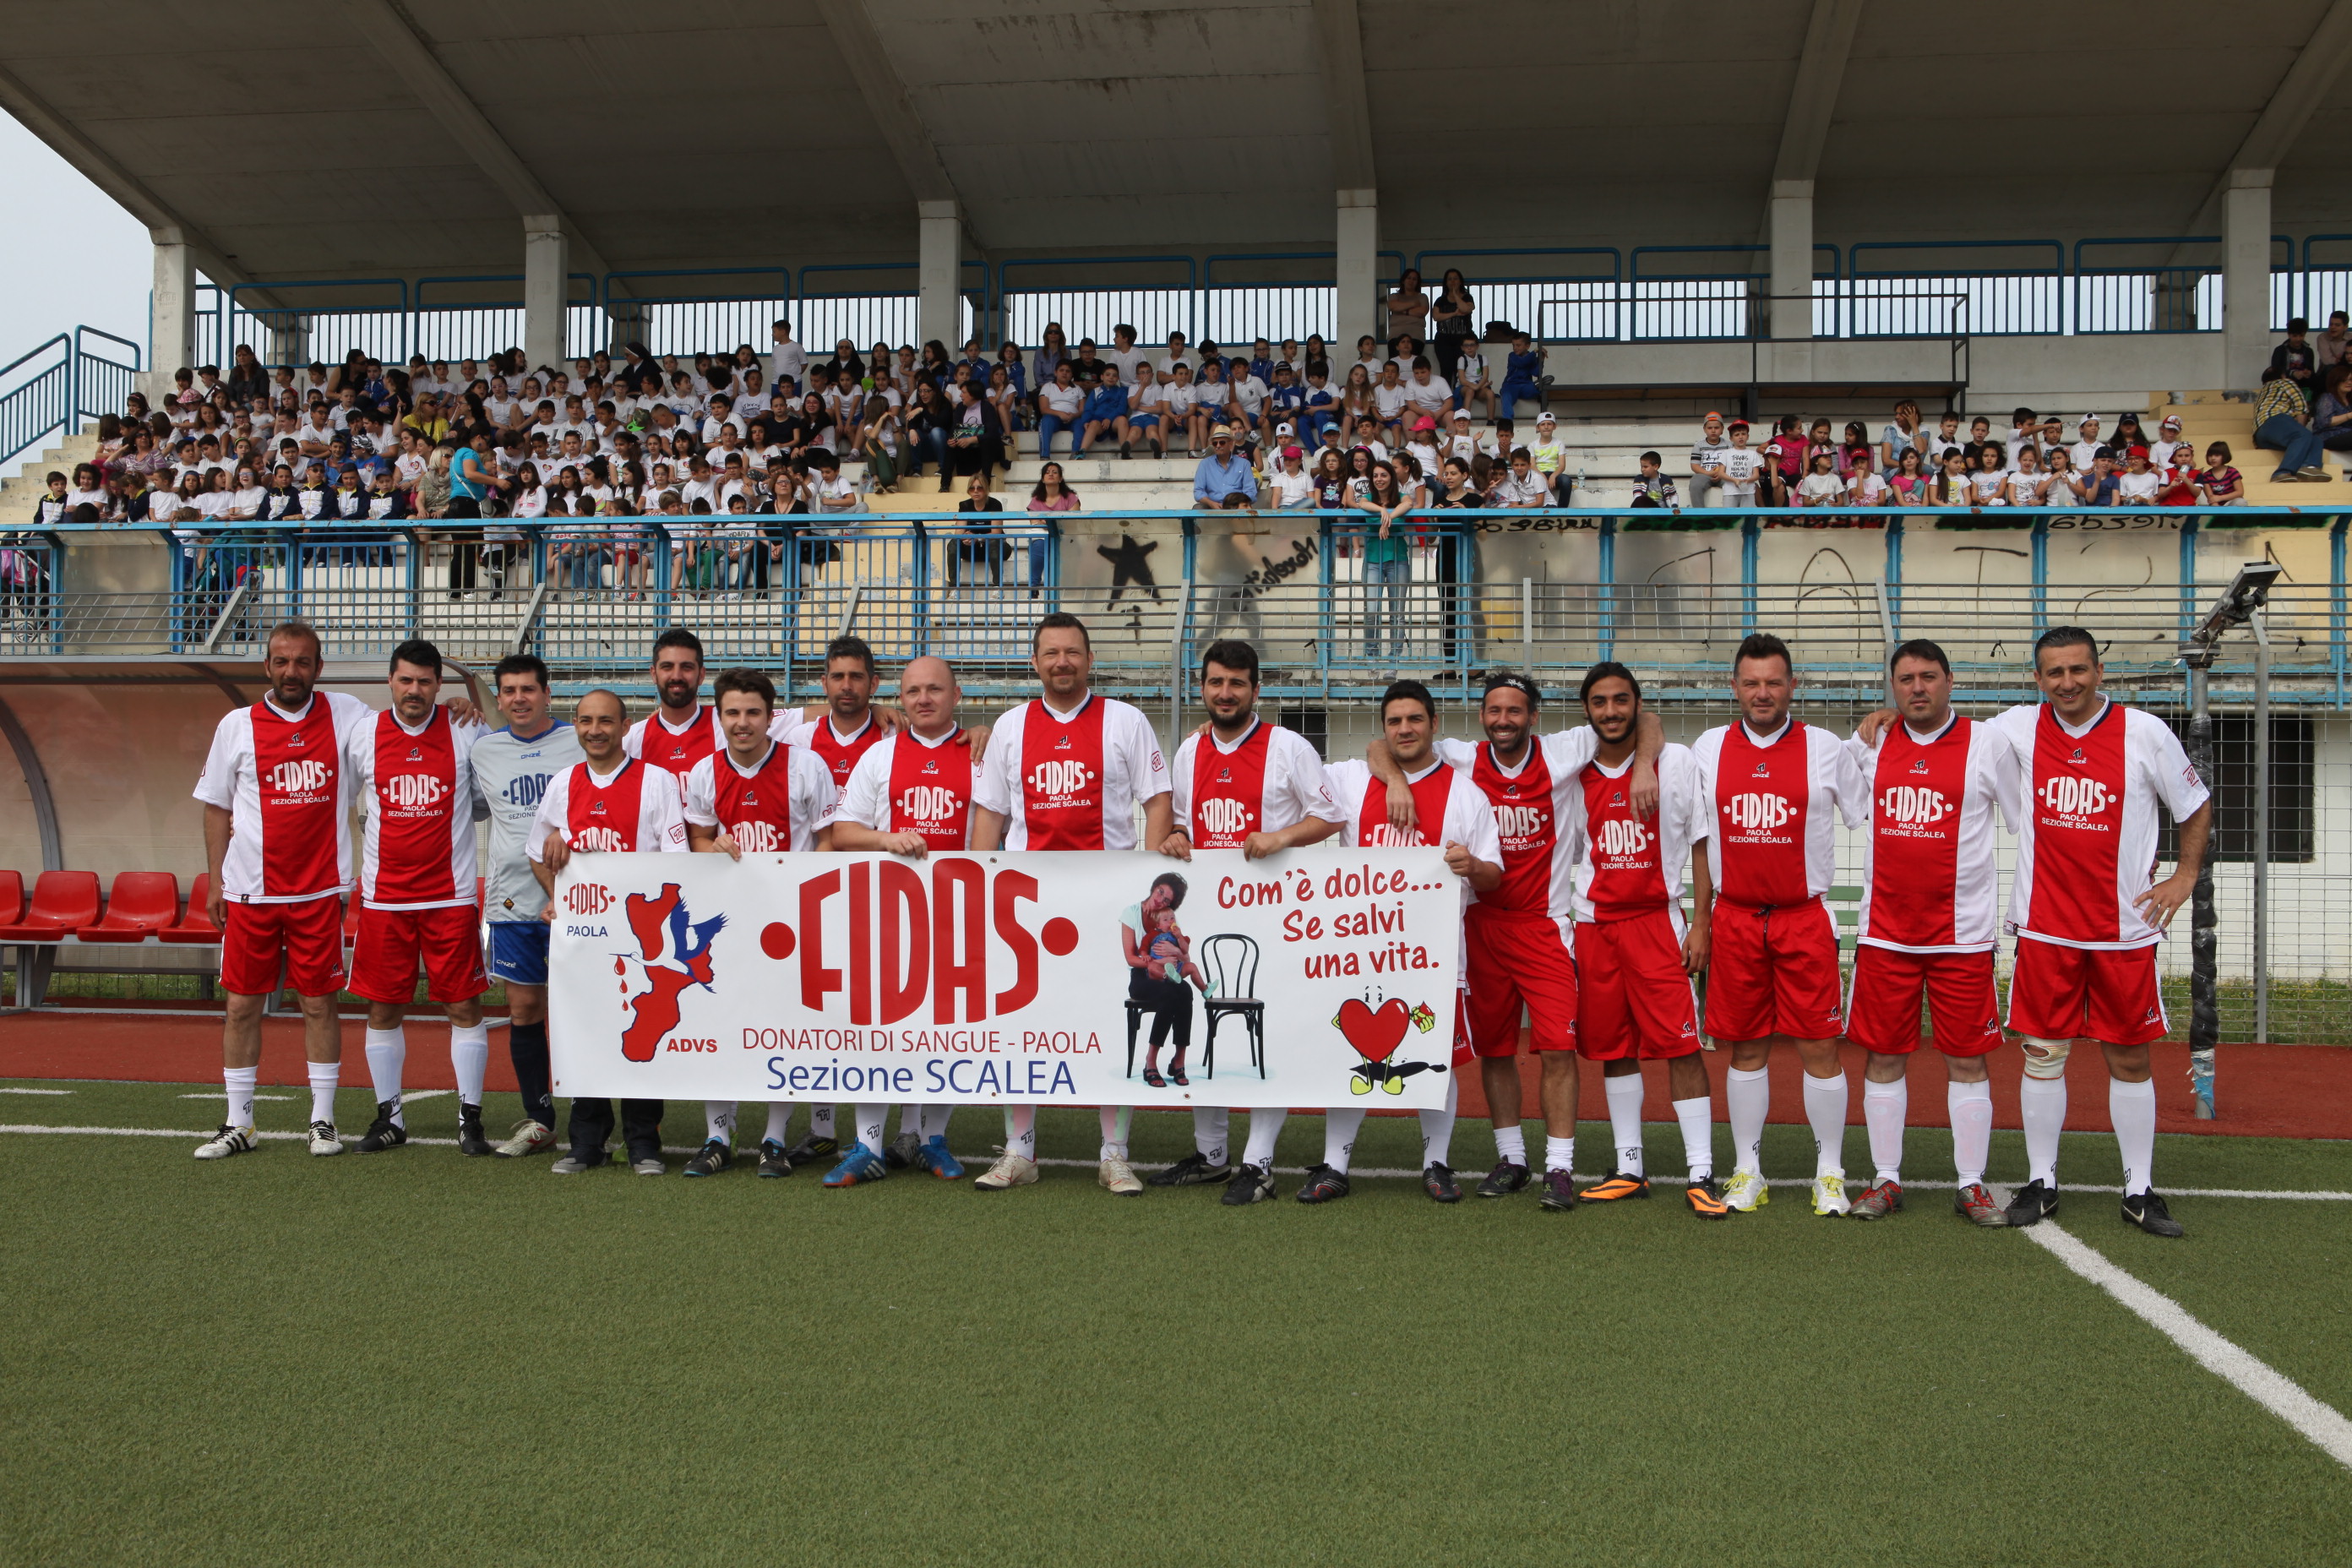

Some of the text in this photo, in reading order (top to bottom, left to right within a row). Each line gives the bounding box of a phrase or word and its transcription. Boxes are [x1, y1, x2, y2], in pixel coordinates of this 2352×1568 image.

[274, 760, 326, 792] FIDAS
[389, 774, 440, 805] FIDAS
[509, 773, 554, 806] FIDA
[1036, 760, 1086, 795] FIDAS
[271, 795, 330, 805] SEZIONE SCALEA
[904, 786, 955, 820] FIDAS
[1732, 792, 1788, 829] FIDAS
[1886, 786, 1944, 823] FIDAS
[2046, 776, 2107, 815] FIDAS
[508, 812, 536, 820] SEZIONE
[1493, 805, 1540, 837] IDAS
[2041, 817, 2109, 831] SEZIONE SCALEA
[2060, 814, 2088, 822] PAOLA
[1518, 840, 1546, 851] SCALEA
[1881, 828, 1946, 839] SEZIONE SCALEA
[1326, 864, 1443, 899] dolce...
[569, 883, 609, 915] FIDAS
[566, 926, 608, 937] PAOLA
[1283, 901, 1405, 942] Se salvi
[799, 858, 1039, 1026] FIDAS
[1304, 942, 1440, 979] una vita.
[667, 1039, 718, 1054] ADVS
[743, 1028, 863, 1051] DONATORI
[871, 1030, 893, 1052] DI
[901, 1030, 1001, 1053] SANGUE
[1023, 1032, 1102, 1054] PAOLA
[767, 1056, 1076, 1095] Sezione SCALEA
